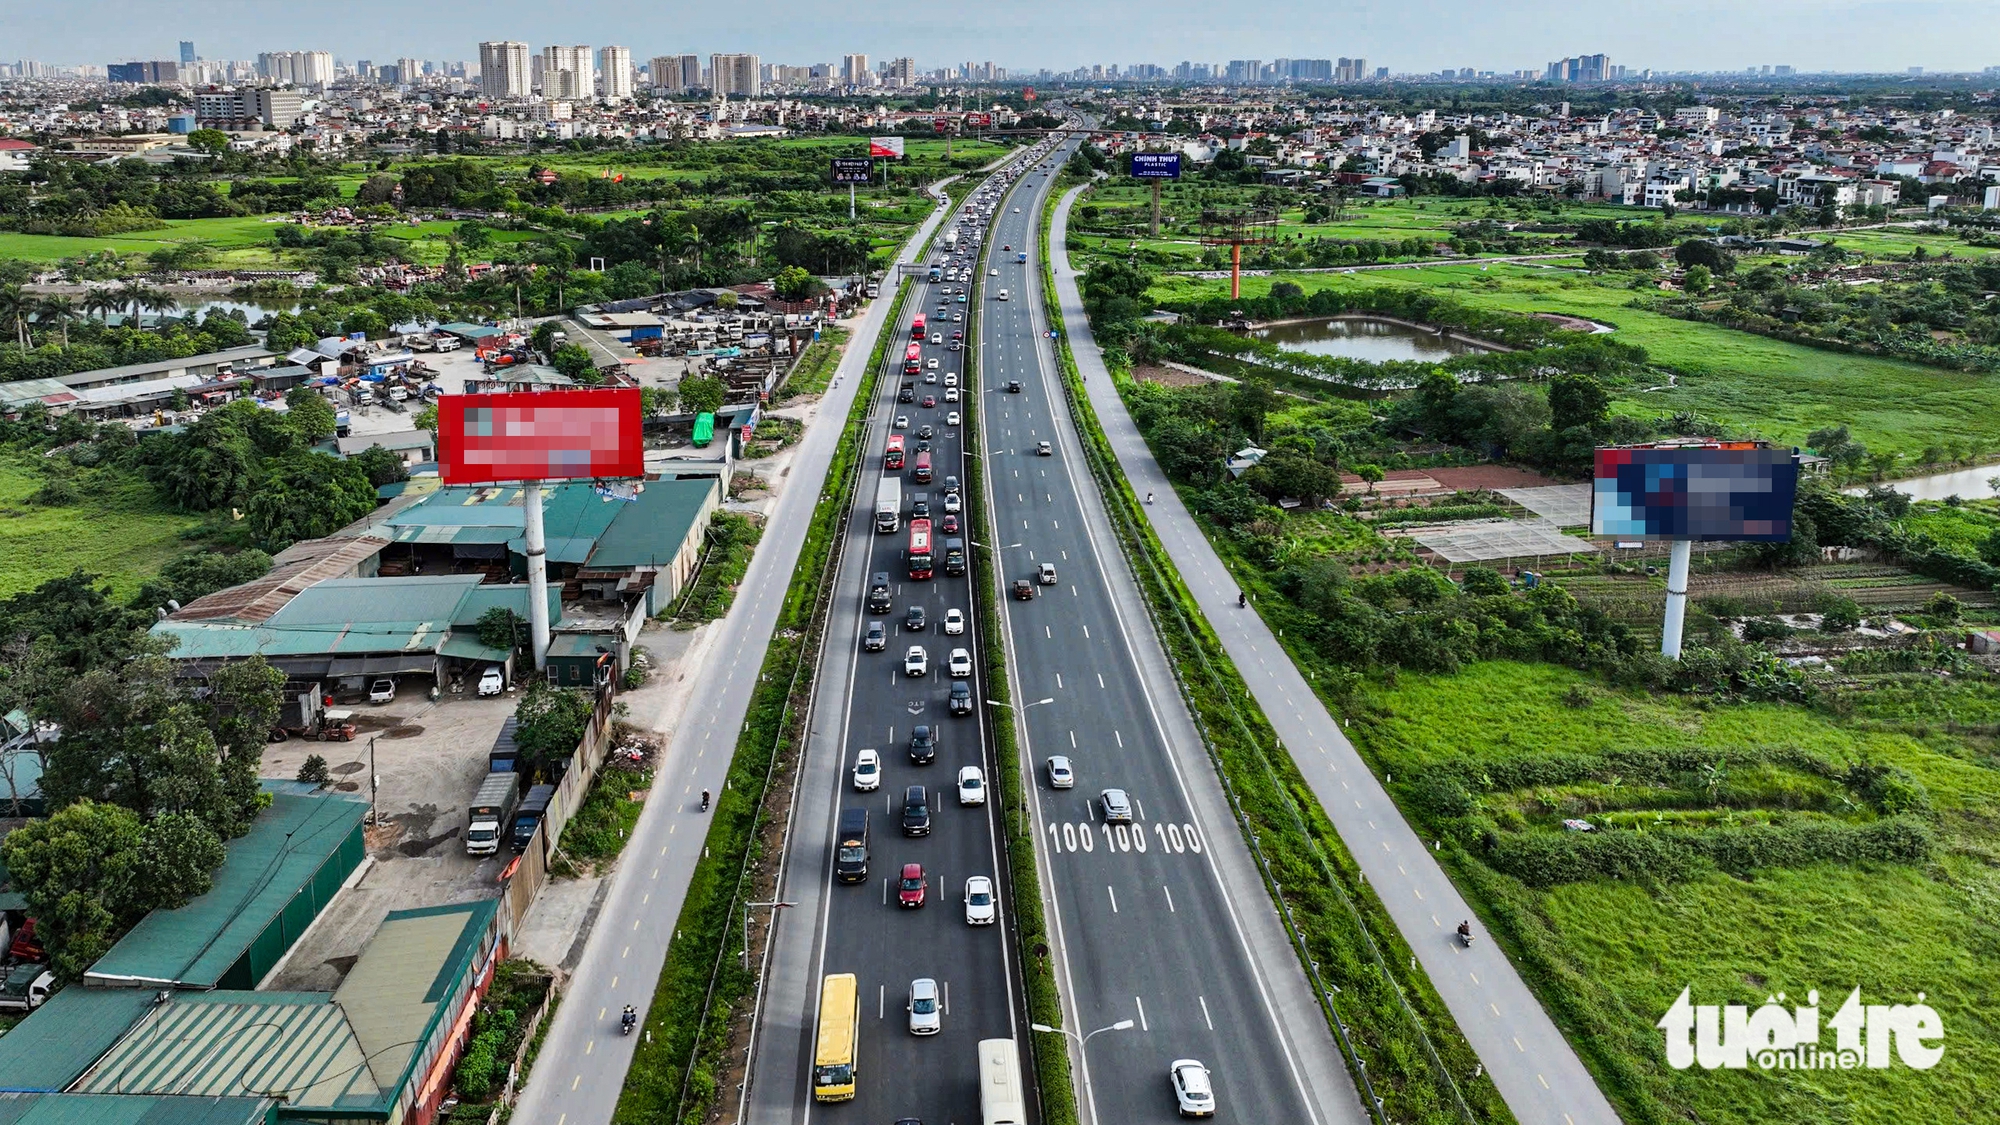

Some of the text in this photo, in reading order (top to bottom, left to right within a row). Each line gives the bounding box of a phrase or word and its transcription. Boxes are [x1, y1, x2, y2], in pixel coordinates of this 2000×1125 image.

[1049, 822, 1202, 853] 100 100 100
